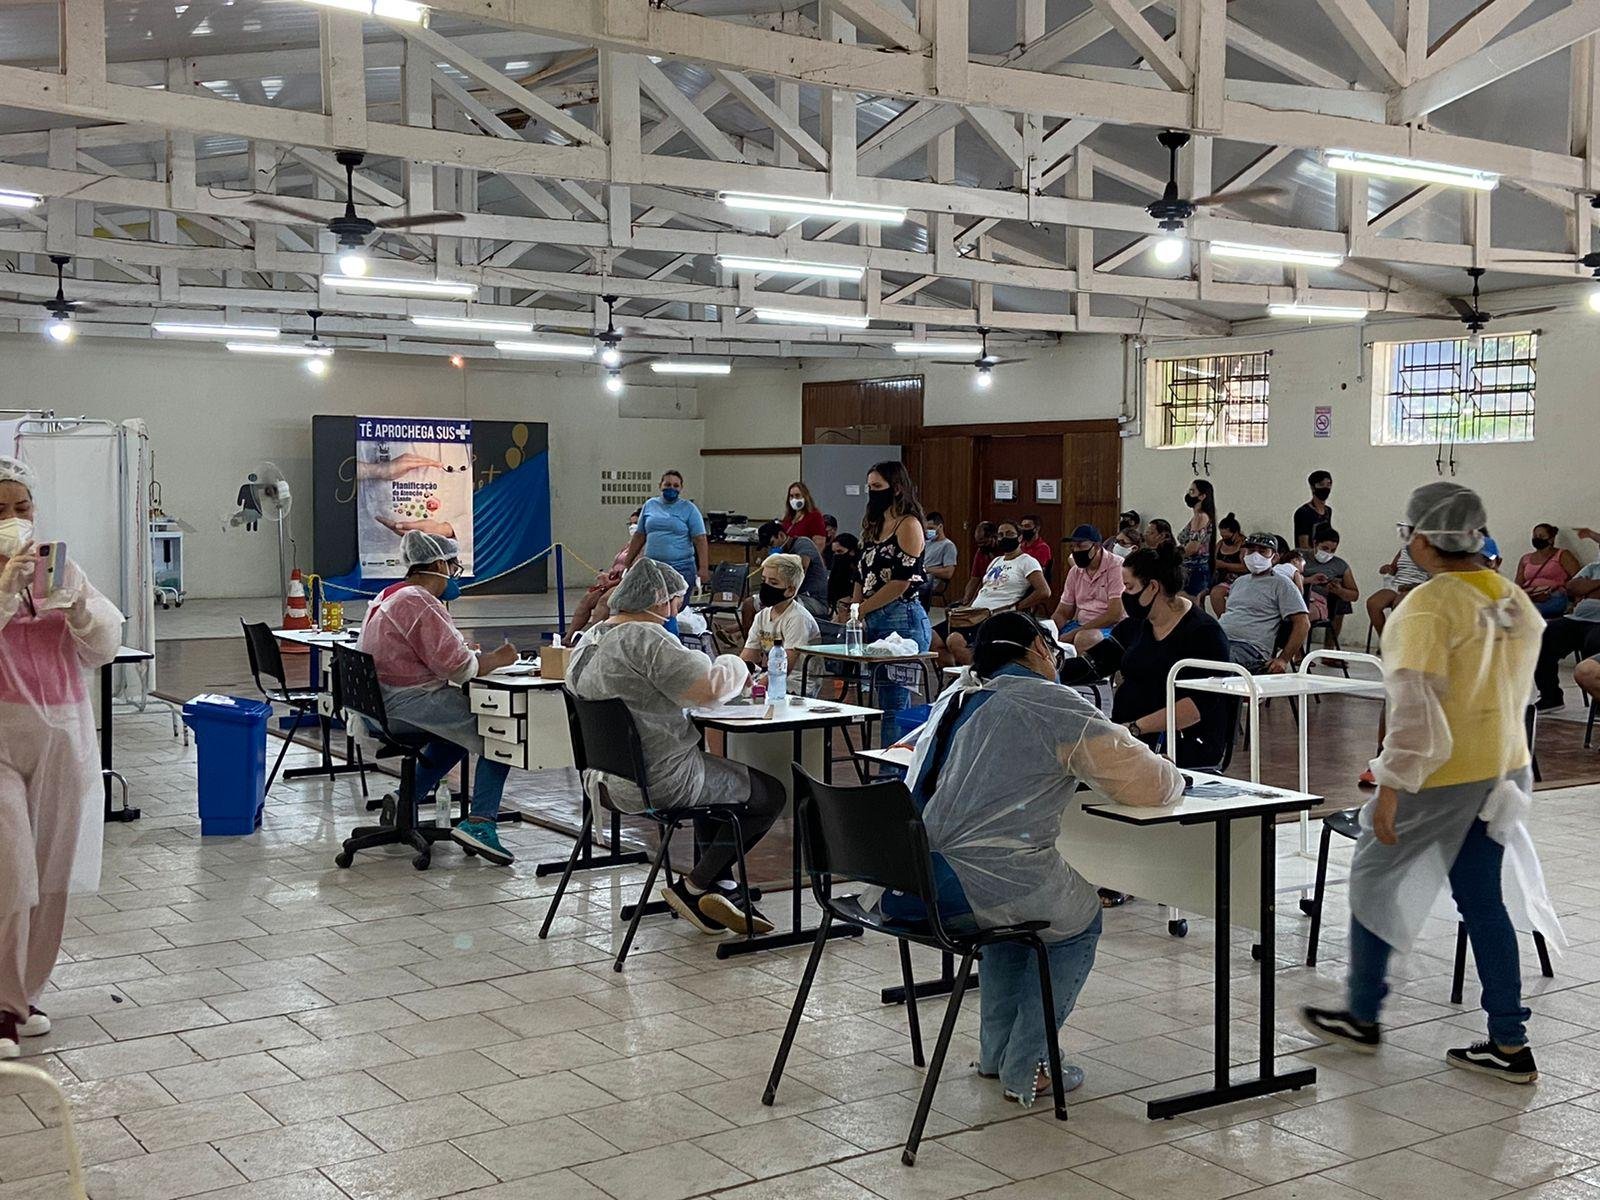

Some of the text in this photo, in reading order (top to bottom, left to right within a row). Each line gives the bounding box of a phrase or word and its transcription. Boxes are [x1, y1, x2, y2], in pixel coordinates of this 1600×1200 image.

[359, 421, 455, 440] TÊ APROCHEGA SUS
[392, 481, 438, 491] Planificação
